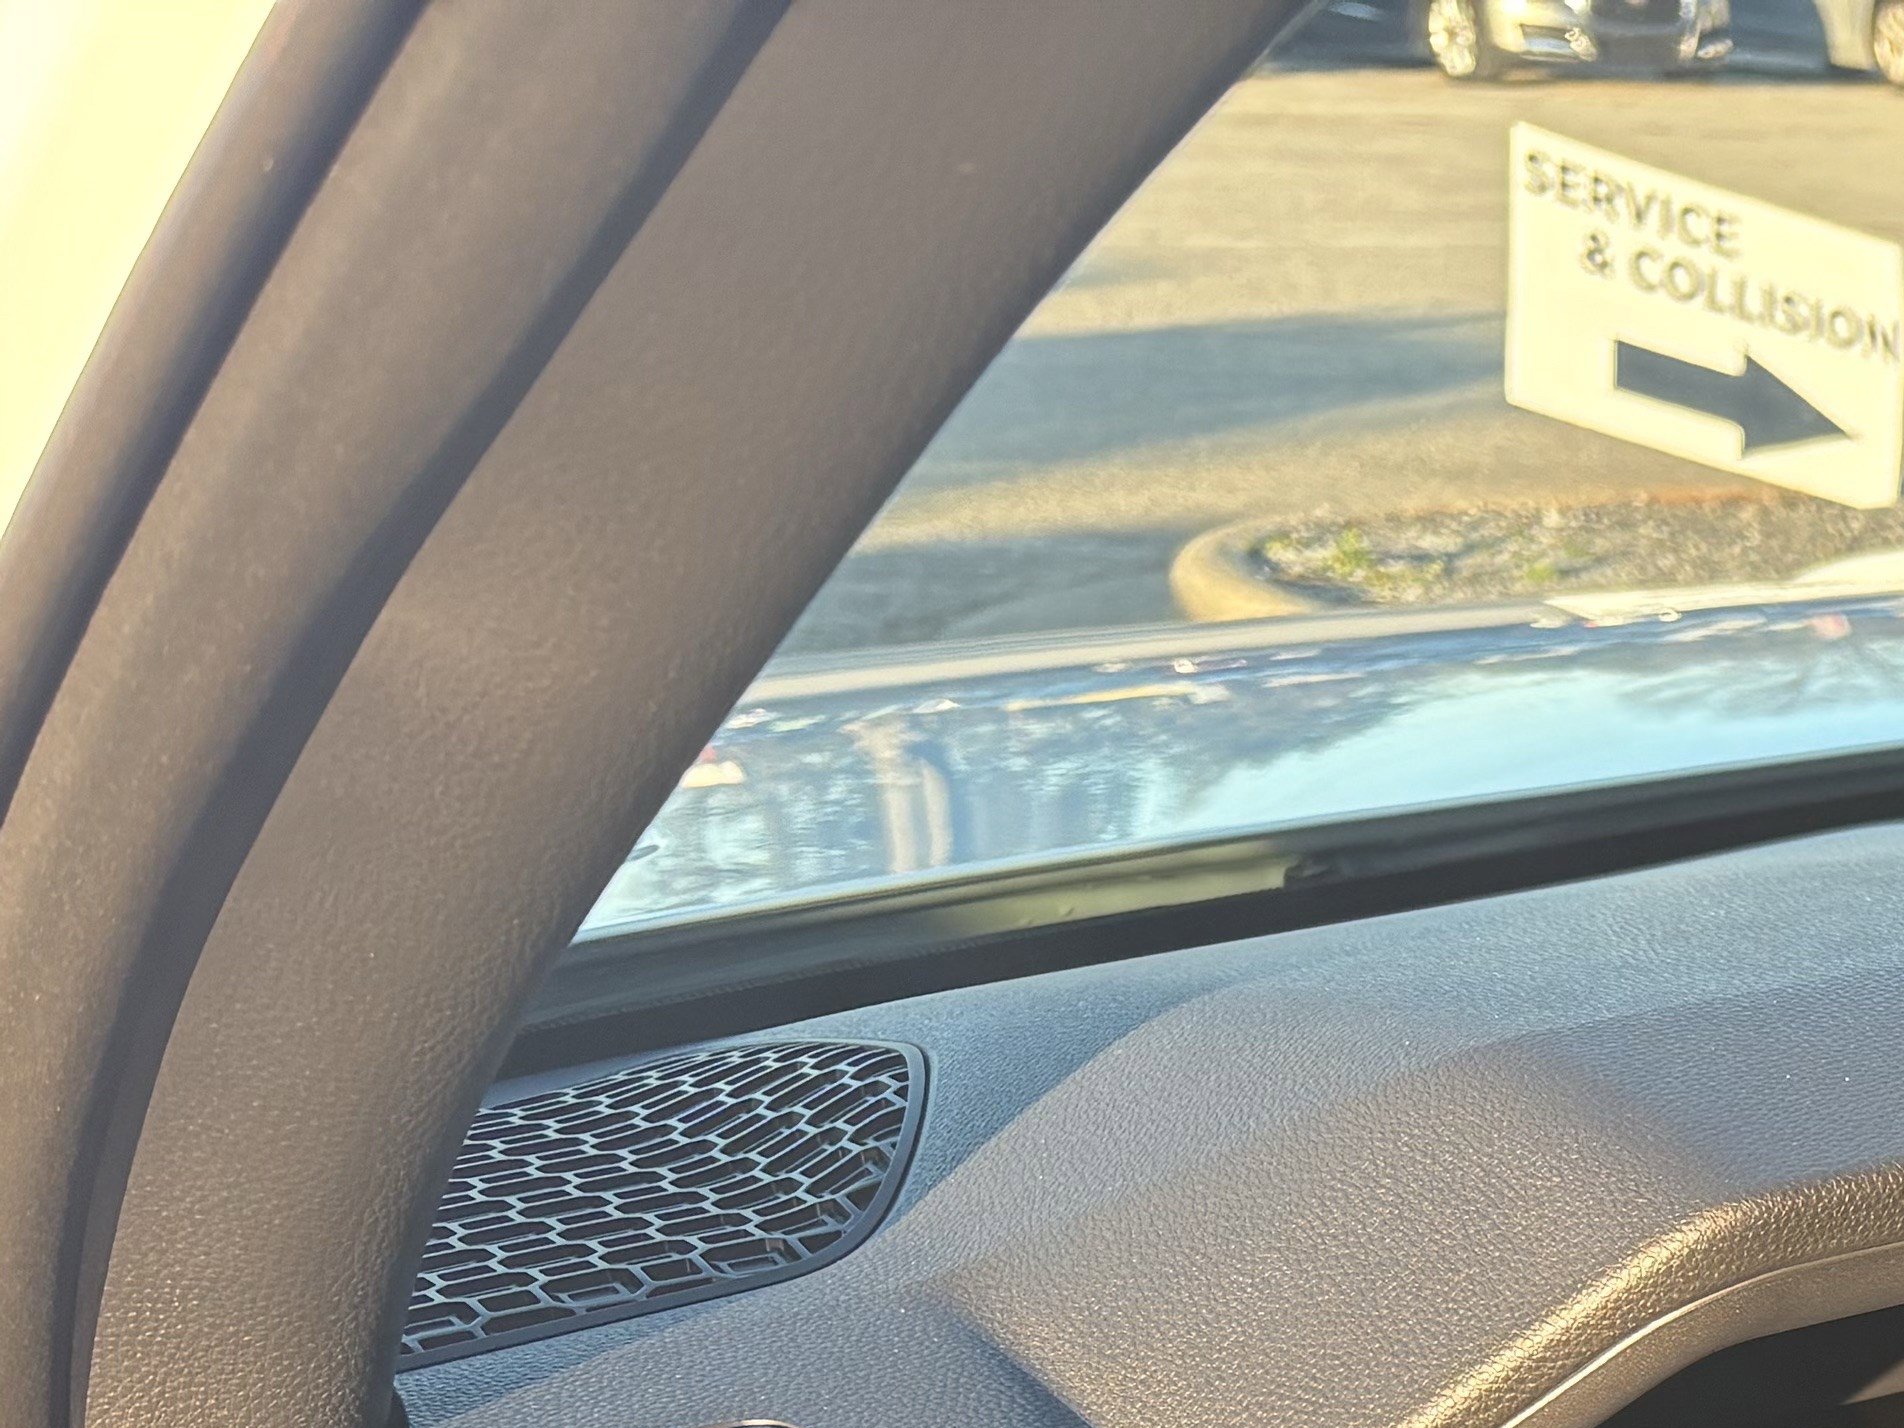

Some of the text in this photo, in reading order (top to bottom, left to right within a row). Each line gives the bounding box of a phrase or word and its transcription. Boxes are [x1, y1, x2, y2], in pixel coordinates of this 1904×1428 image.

[1523, 150, 1742, 261] SERVICE
[1581, 230, 1901, 363] & COLLISION
